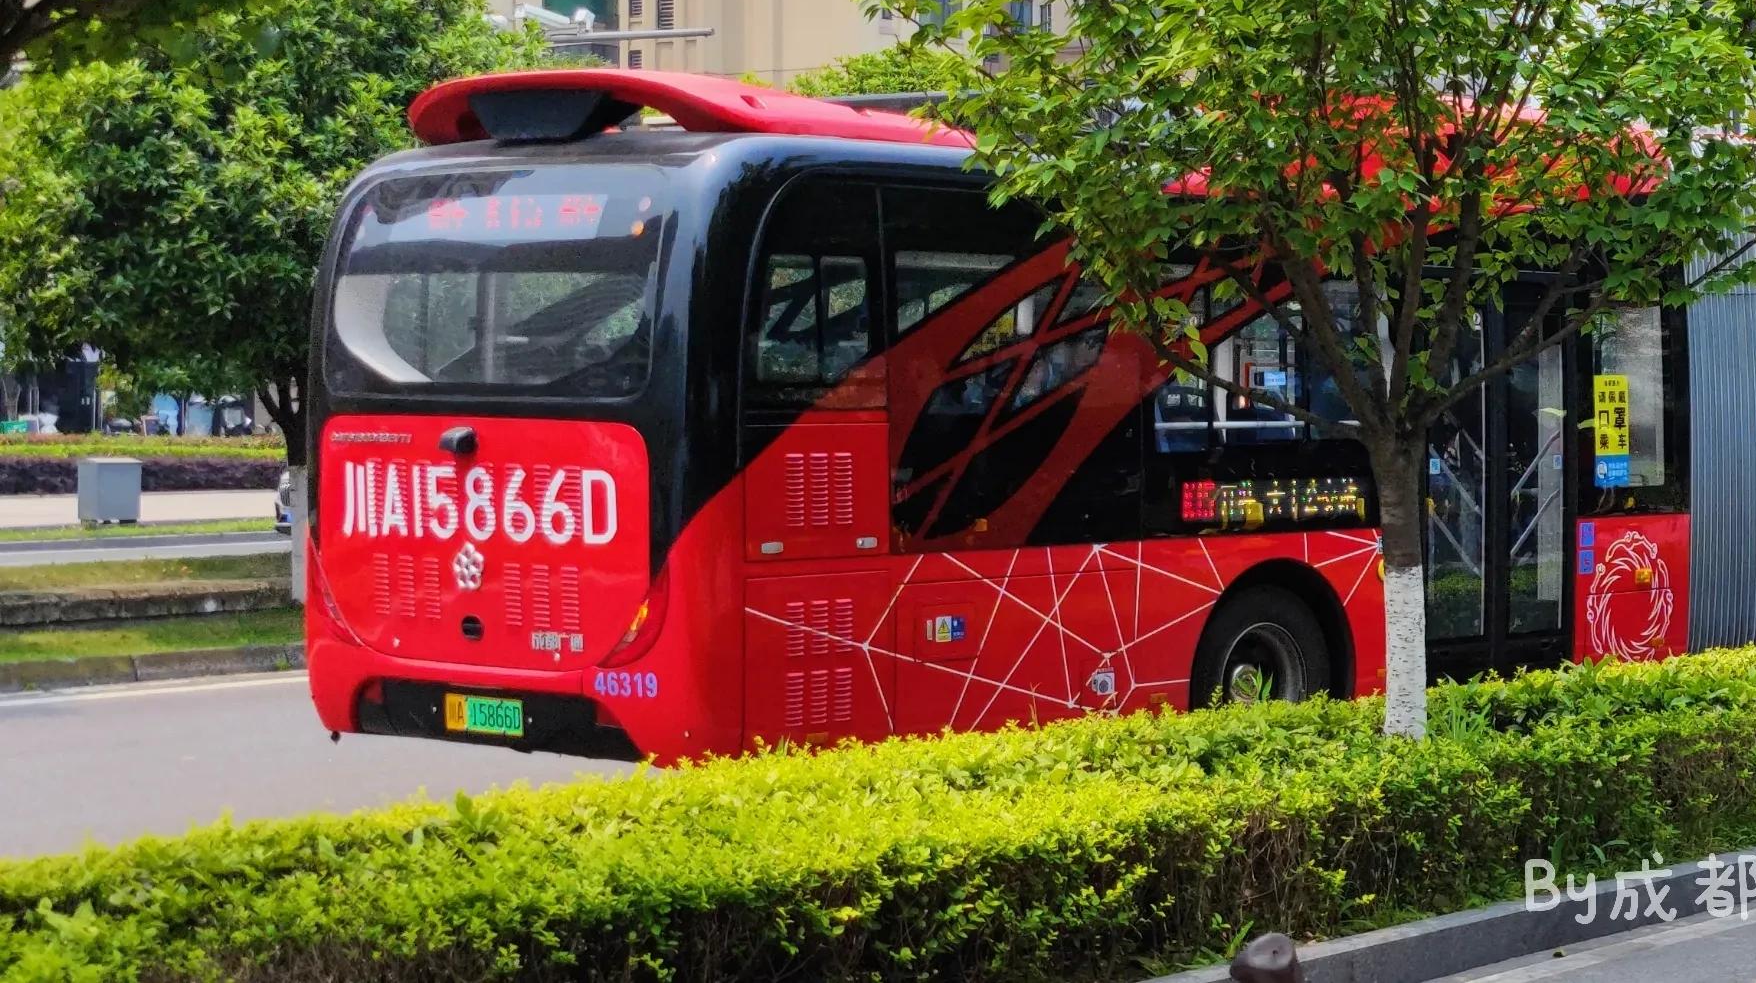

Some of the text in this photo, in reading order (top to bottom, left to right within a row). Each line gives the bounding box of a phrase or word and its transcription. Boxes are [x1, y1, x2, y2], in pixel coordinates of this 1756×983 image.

[1598, 407, 1626, 430] 口罩
[1599, 433, 1627, 450] 乘车
[343, 461, 618, 545] 川A15866D
[594, 671, 658, 698] 46319
